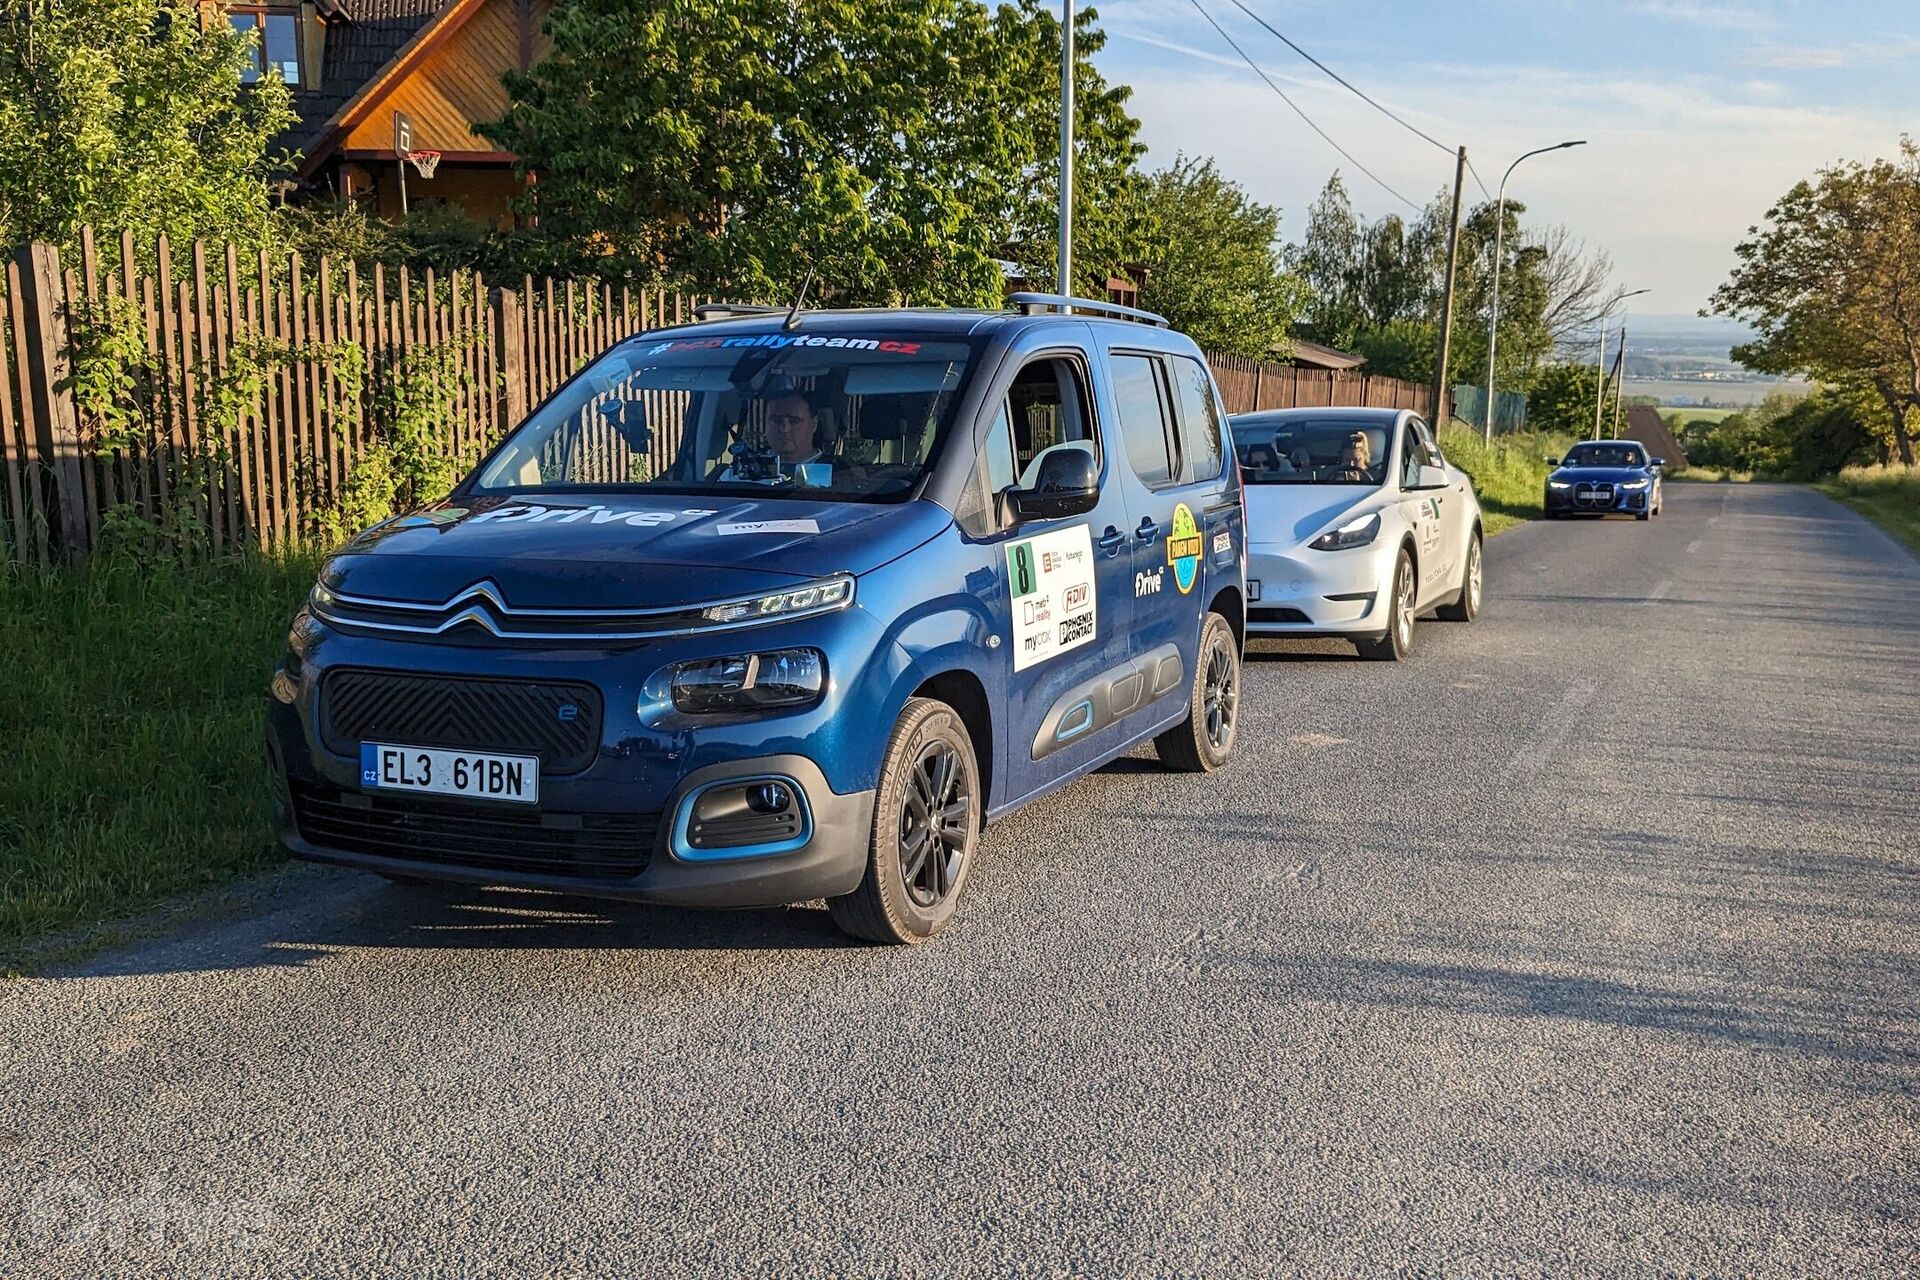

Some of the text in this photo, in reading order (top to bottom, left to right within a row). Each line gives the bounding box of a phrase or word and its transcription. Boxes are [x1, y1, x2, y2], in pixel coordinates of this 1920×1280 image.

[1015, 545, 1028, 594] 8
[1068, 622, 1093, 642] CONTACT
[363, 750, 523, 796] CZ EL3 61BN
